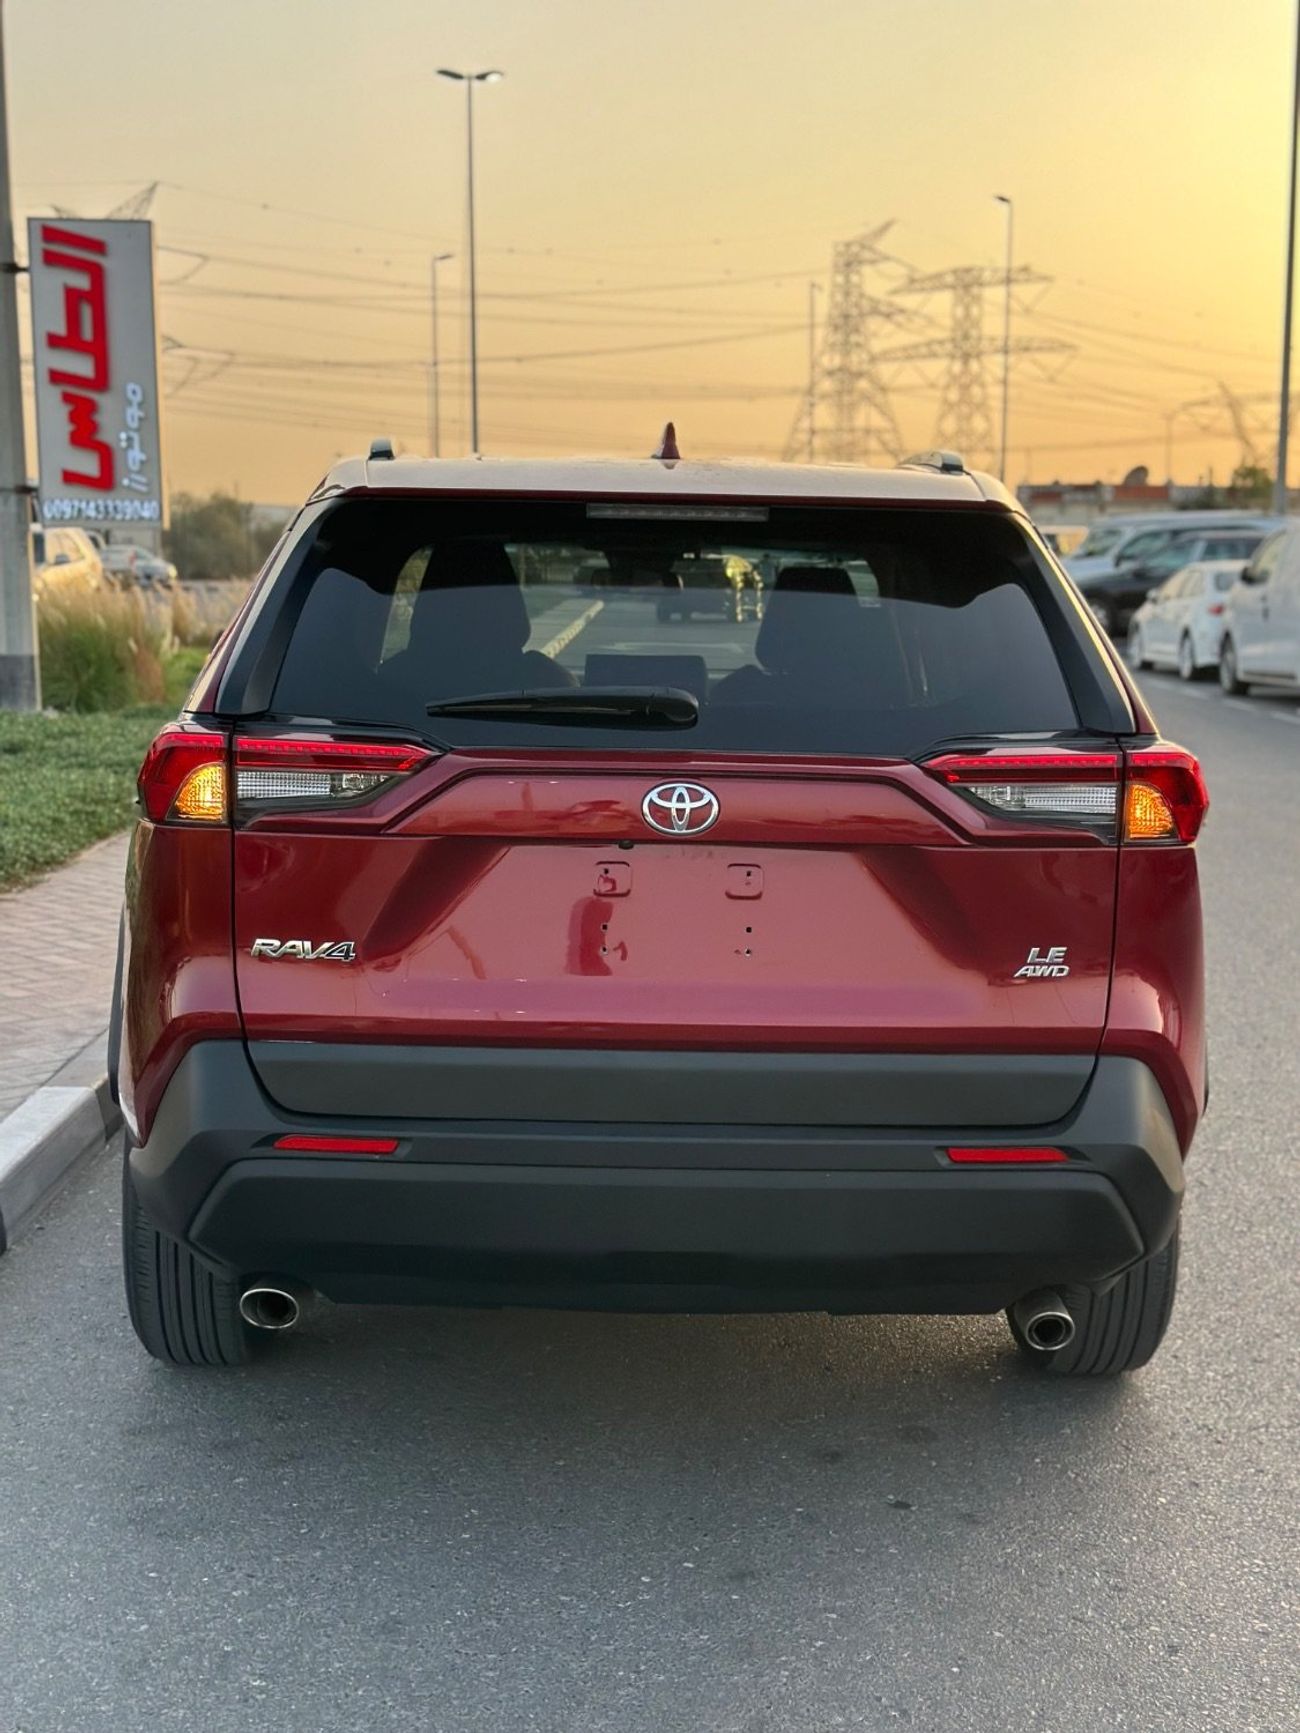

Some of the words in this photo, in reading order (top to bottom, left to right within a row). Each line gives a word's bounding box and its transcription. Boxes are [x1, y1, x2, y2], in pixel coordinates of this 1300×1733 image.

[41, 224, 115, 491] الطاس
[250, 938, 356, 962] RAV4
[1026, 946, 1068, 964] LE
[1013, 965, 1070, 978] AWD
